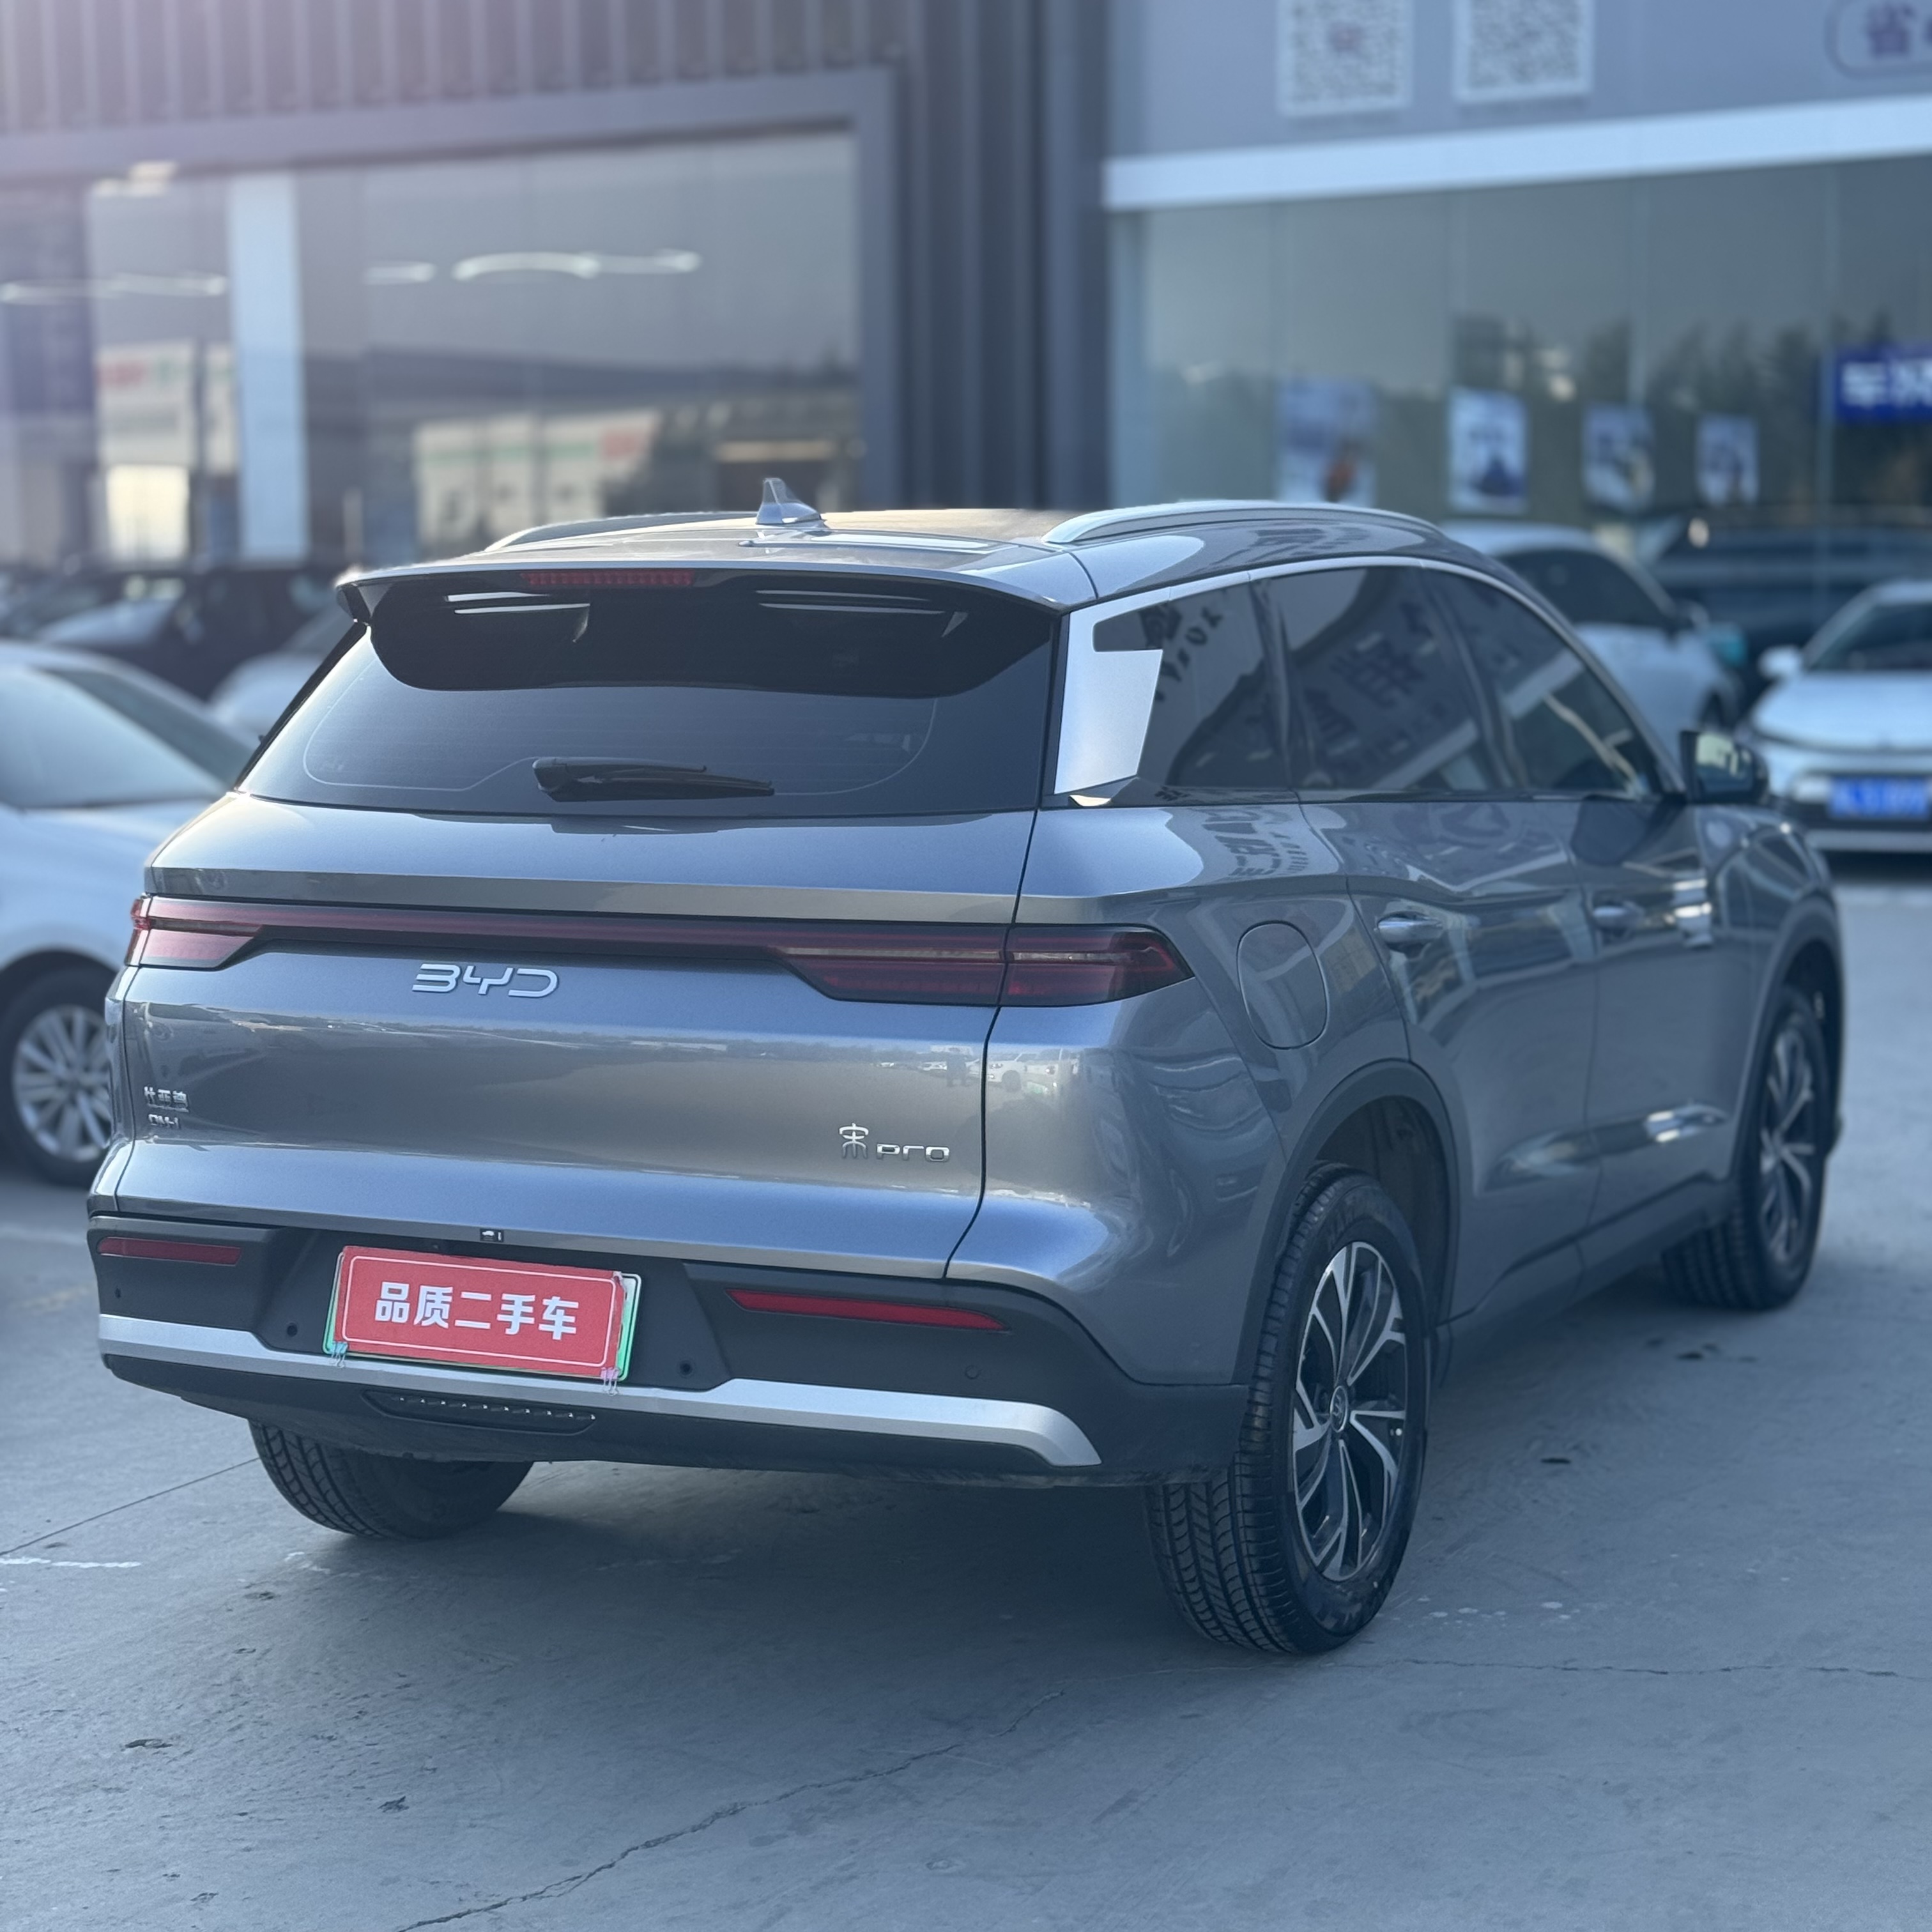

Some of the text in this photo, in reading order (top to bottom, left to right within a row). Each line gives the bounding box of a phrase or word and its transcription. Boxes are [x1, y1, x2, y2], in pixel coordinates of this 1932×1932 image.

[1864, 1, 1932, 57] 省
[412, 963, 560, 999] BYD
[374, 1280, 579, 1341] 品质二手车
